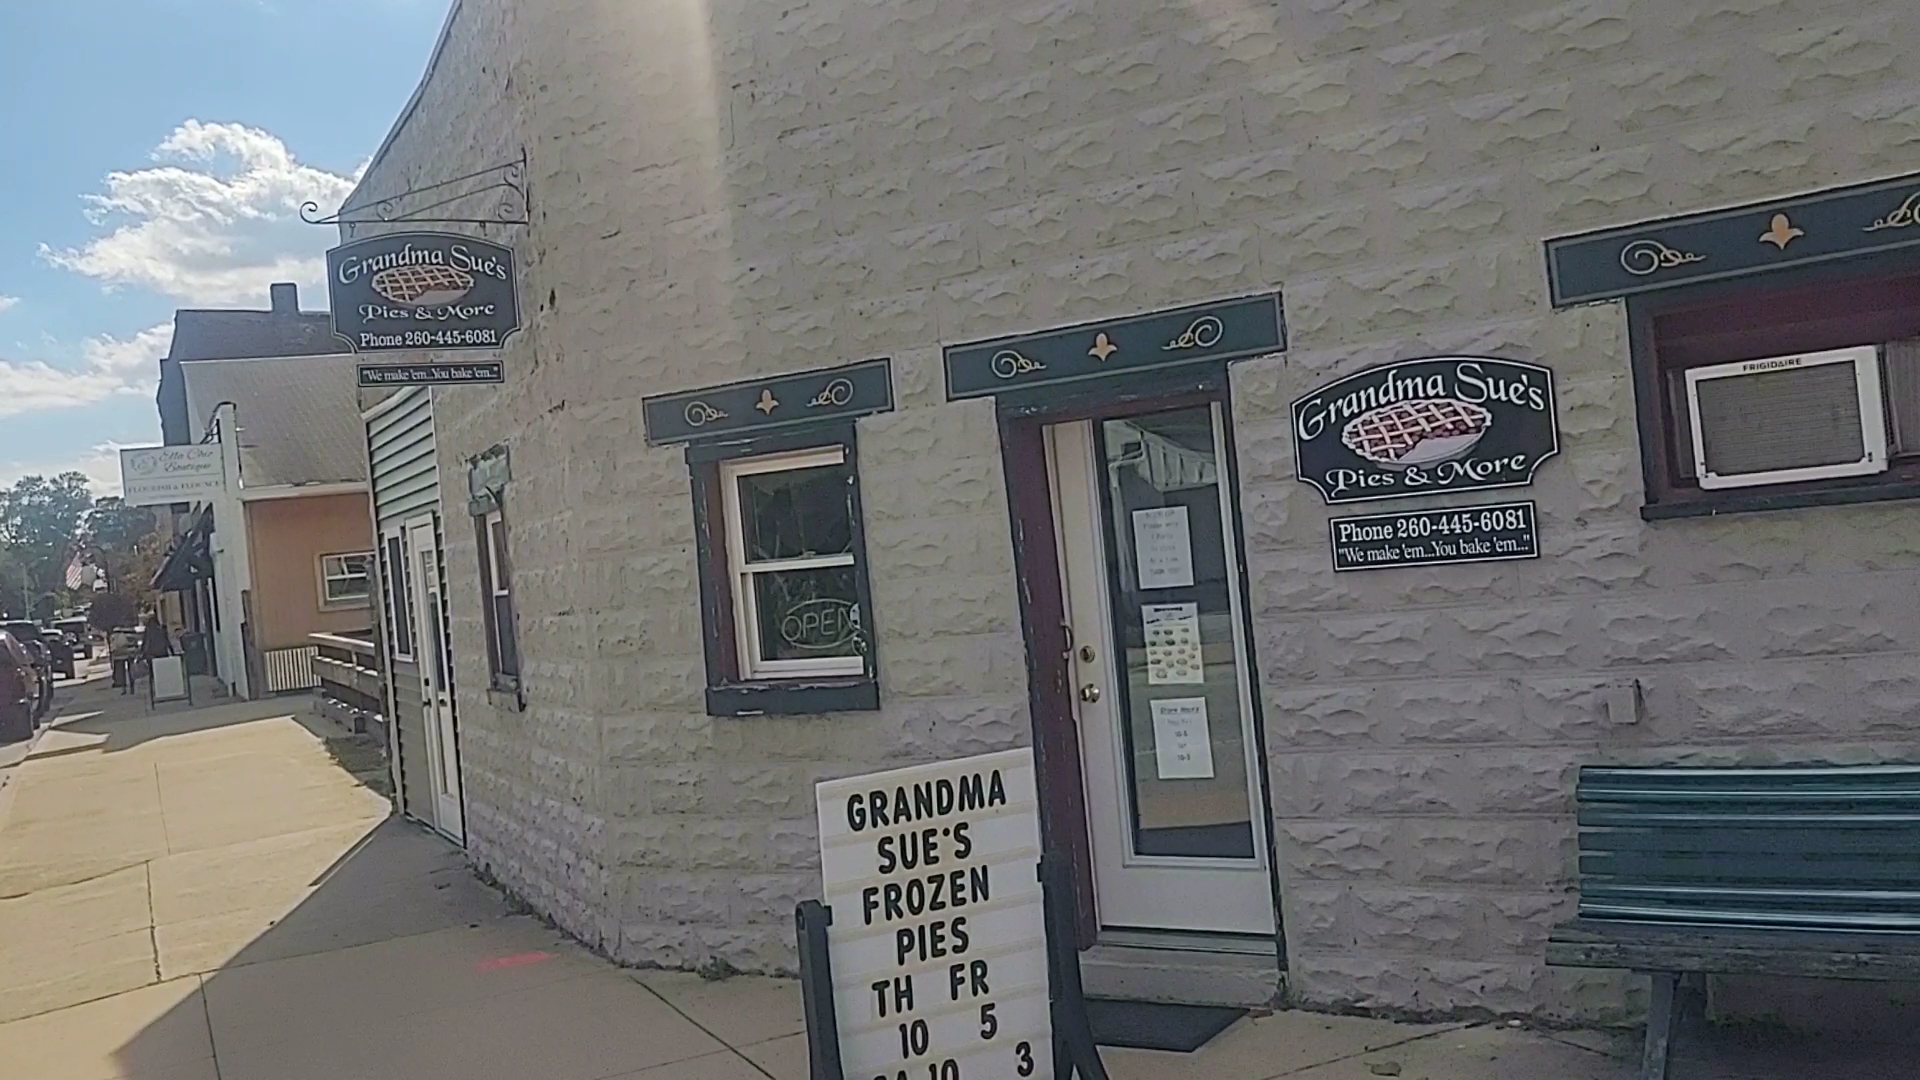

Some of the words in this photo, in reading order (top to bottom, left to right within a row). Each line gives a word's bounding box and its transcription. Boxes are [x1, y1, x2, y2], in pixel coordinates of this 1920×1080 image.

[339, 243, 444, 284] Grandma
[450, 244, 507, 280] Sue's
[359, 304, 409, 324] Pies
[415, 306, 434, 320] &
[437, 304, 495, 320] More
[360, 332, 402, 347] Phone
[405, 329, 497, 345] 260-445-6081
[384, 368, 410, 380] make
[451, 367, 473, 378] bake
[1742, 358, 1802, 371] FRIGIDAIRE
[1299, 369, 1447, 440] Grandma
[1455, 363, 1545, 411] Sue's
[1325, 468, 1395, 498] Pies
[1404, 466, 1431, 486] &
[1437, 454, 1526, 485] More
[1339, 523, 1393, 542] Phone
[1397, 509, 1526, 538] 260-445-6081
[1339, 548, 1364, 563] "We
[1367, 545, 1400, 561] make
[1460, 538, 1490, 554] bake
[781, 607, 856, 641] OPEN
[847, 769, 1006, 831] GRANDMA
[877, 821, 972, 874] SUE'S
[862, 864, 989, 925] FROZEN
[897, 916, 970, 966] PIES
[872, 974, 914, 1018] TH
[949, 959, 990, 1001] FR
[899, 1019, 929, 1059] 10
[980, 1002, 998, 1040] 5
[1015, 1041, 1034, 1077] 3
